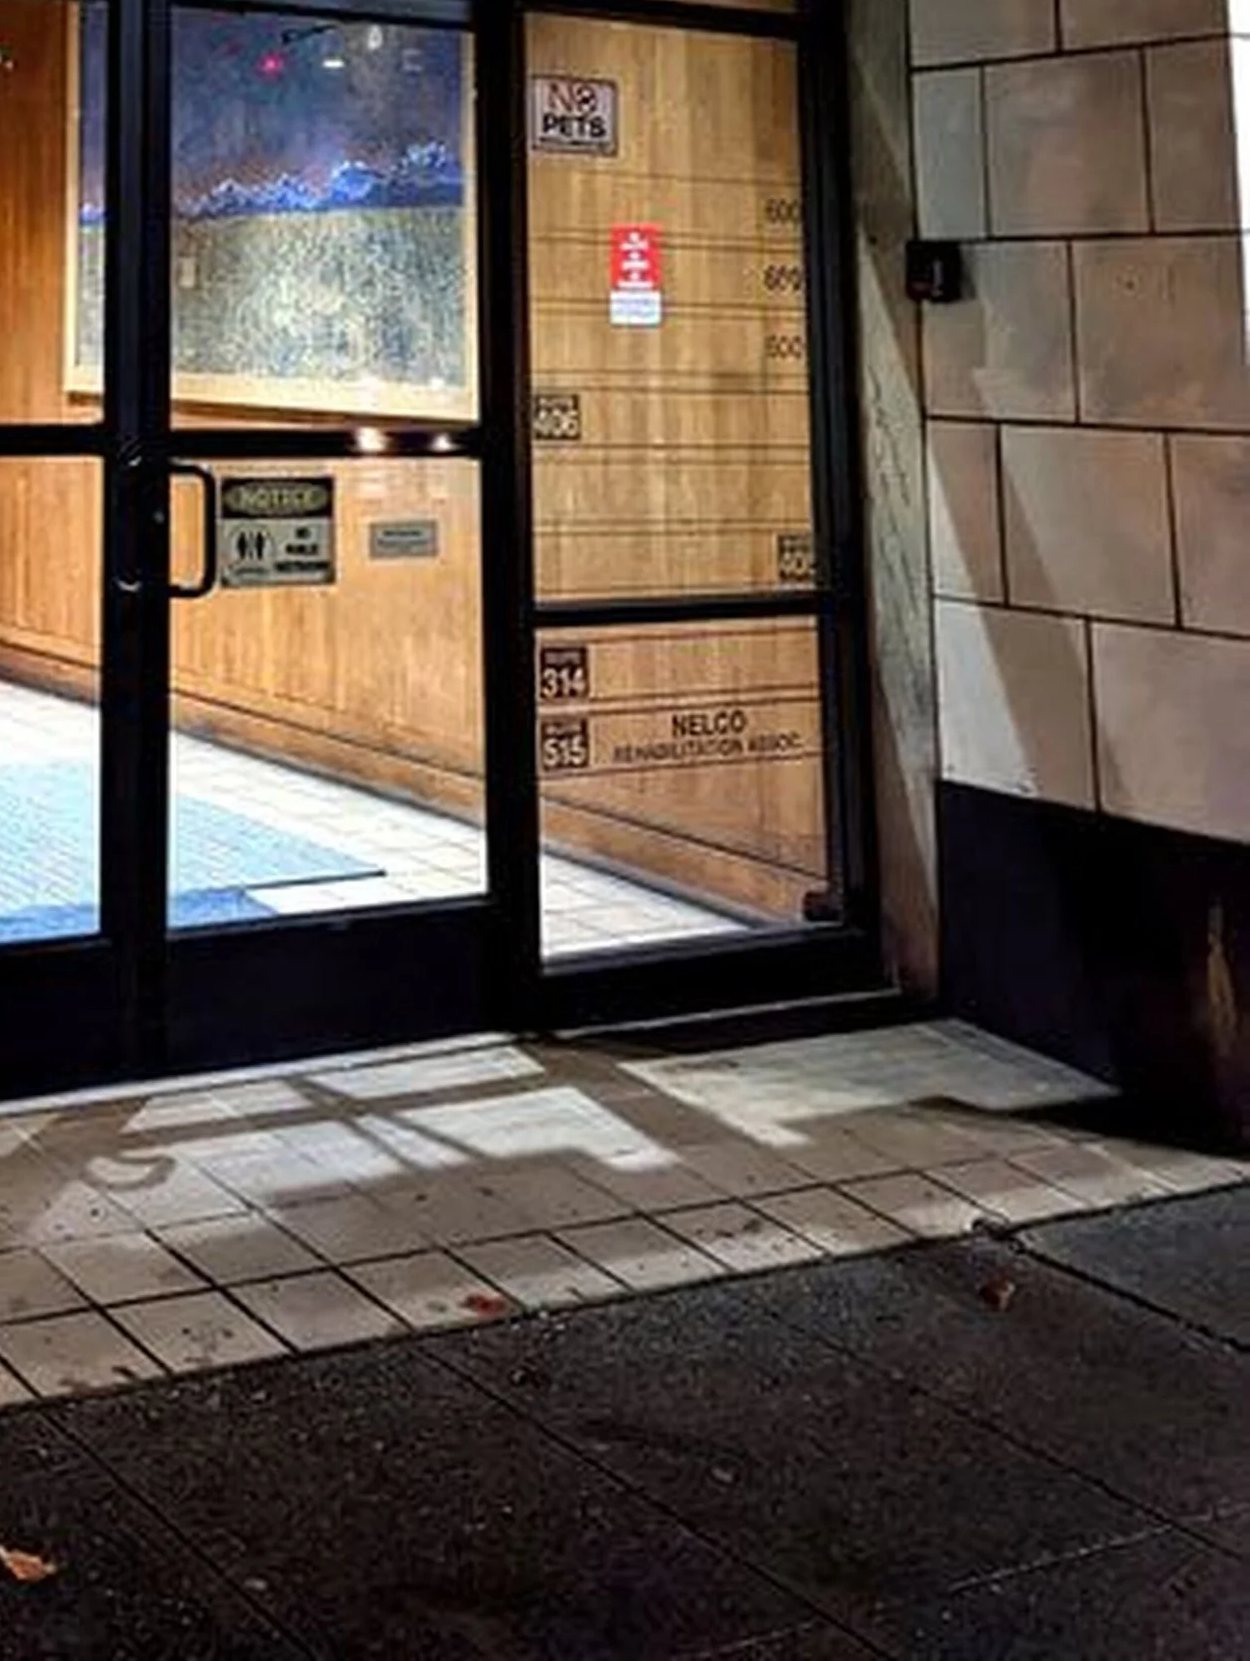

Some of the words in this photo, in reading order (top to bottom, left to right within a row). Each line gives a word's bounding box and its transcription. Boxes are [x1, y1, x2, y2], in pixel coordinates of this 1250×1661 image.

[549, 82, 597, 113] NO
[543, 113, 607, 138] PETS
[543, 667, 585, 697] 314
[672, 710, 747, 737] NELCO
